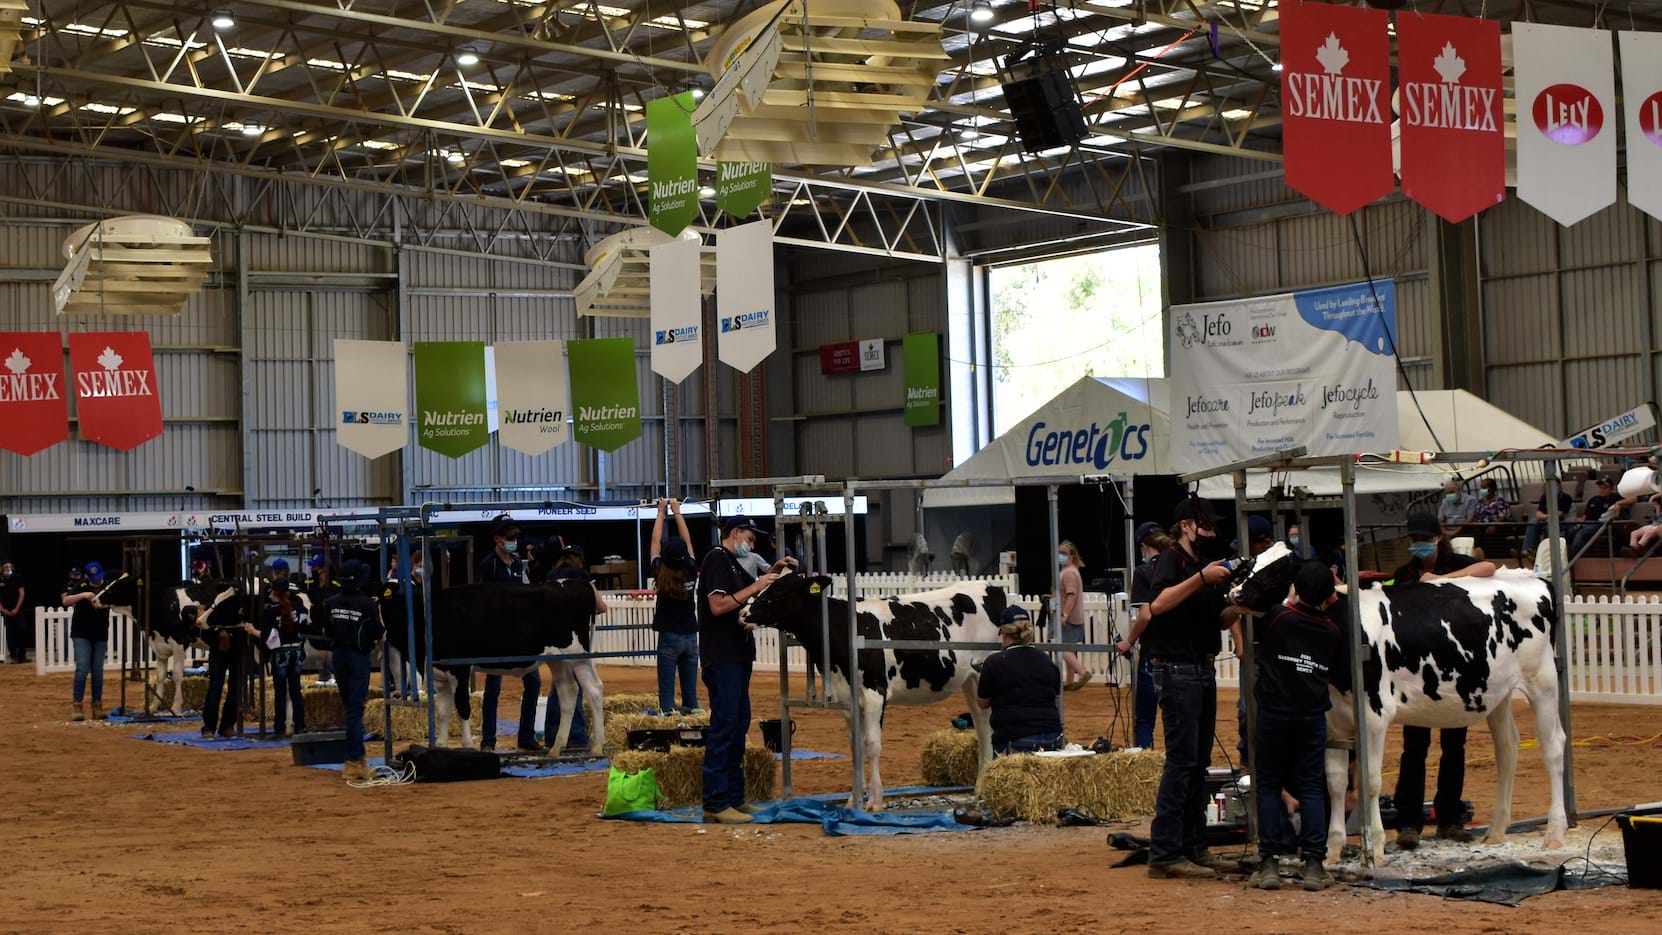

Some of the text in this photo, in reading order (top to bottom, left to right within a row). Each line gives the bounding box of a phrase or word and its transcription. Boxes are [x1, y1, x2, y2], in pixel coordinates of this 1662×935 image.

[1288, 72, 1383, 124] SEMEX
[1405, 81, 1497, 132] SEMEX
[1546, 93, 1589, 134] LELY
[721, 161, 767, 181] Nutrien
[653, 176, 695, 200] Nutrien
[720, 180, 756, 196] Ag Solutions
[652, 200, 686, 215] Ag Solutions
[742, 310, 769, 321] DAIRY
[675, 326, 698, 335] DAIRY
[1201, 313, 1231, 344] Jefo
[0, 373, 59, 401] EMEX
[77, 370, 152, 397] SEMEX
[908, 386, 937, 400] Nutrien
[1248, 383, 1306, 416] Jefopeak
[1321, 377, 1379, 410] Jefocycle
[369, 411, 402, 420] DAIRY
[579, 404, 636, 420] Nutrien
[1186, 396, 1230, 419] Jefocare
[424, 410, 484, 425] Nutrien
[505, 408, 562, 424] Nutrien
[1602, 412, 1636, 434] DAIRY
[423, 428, 470, 438] Ag Solutions
[540, 425, 560, 433] Wool
[579, 422, 623, 433] Ag Solutions
[1026, 412, 1150, 470] Genetics
[211, 513, 312, 523] CENTRAL STEEL BUILD
[538, 507, 597, 515] PIONEER SEED
[74, 516, 121, 526] MAXCARE
